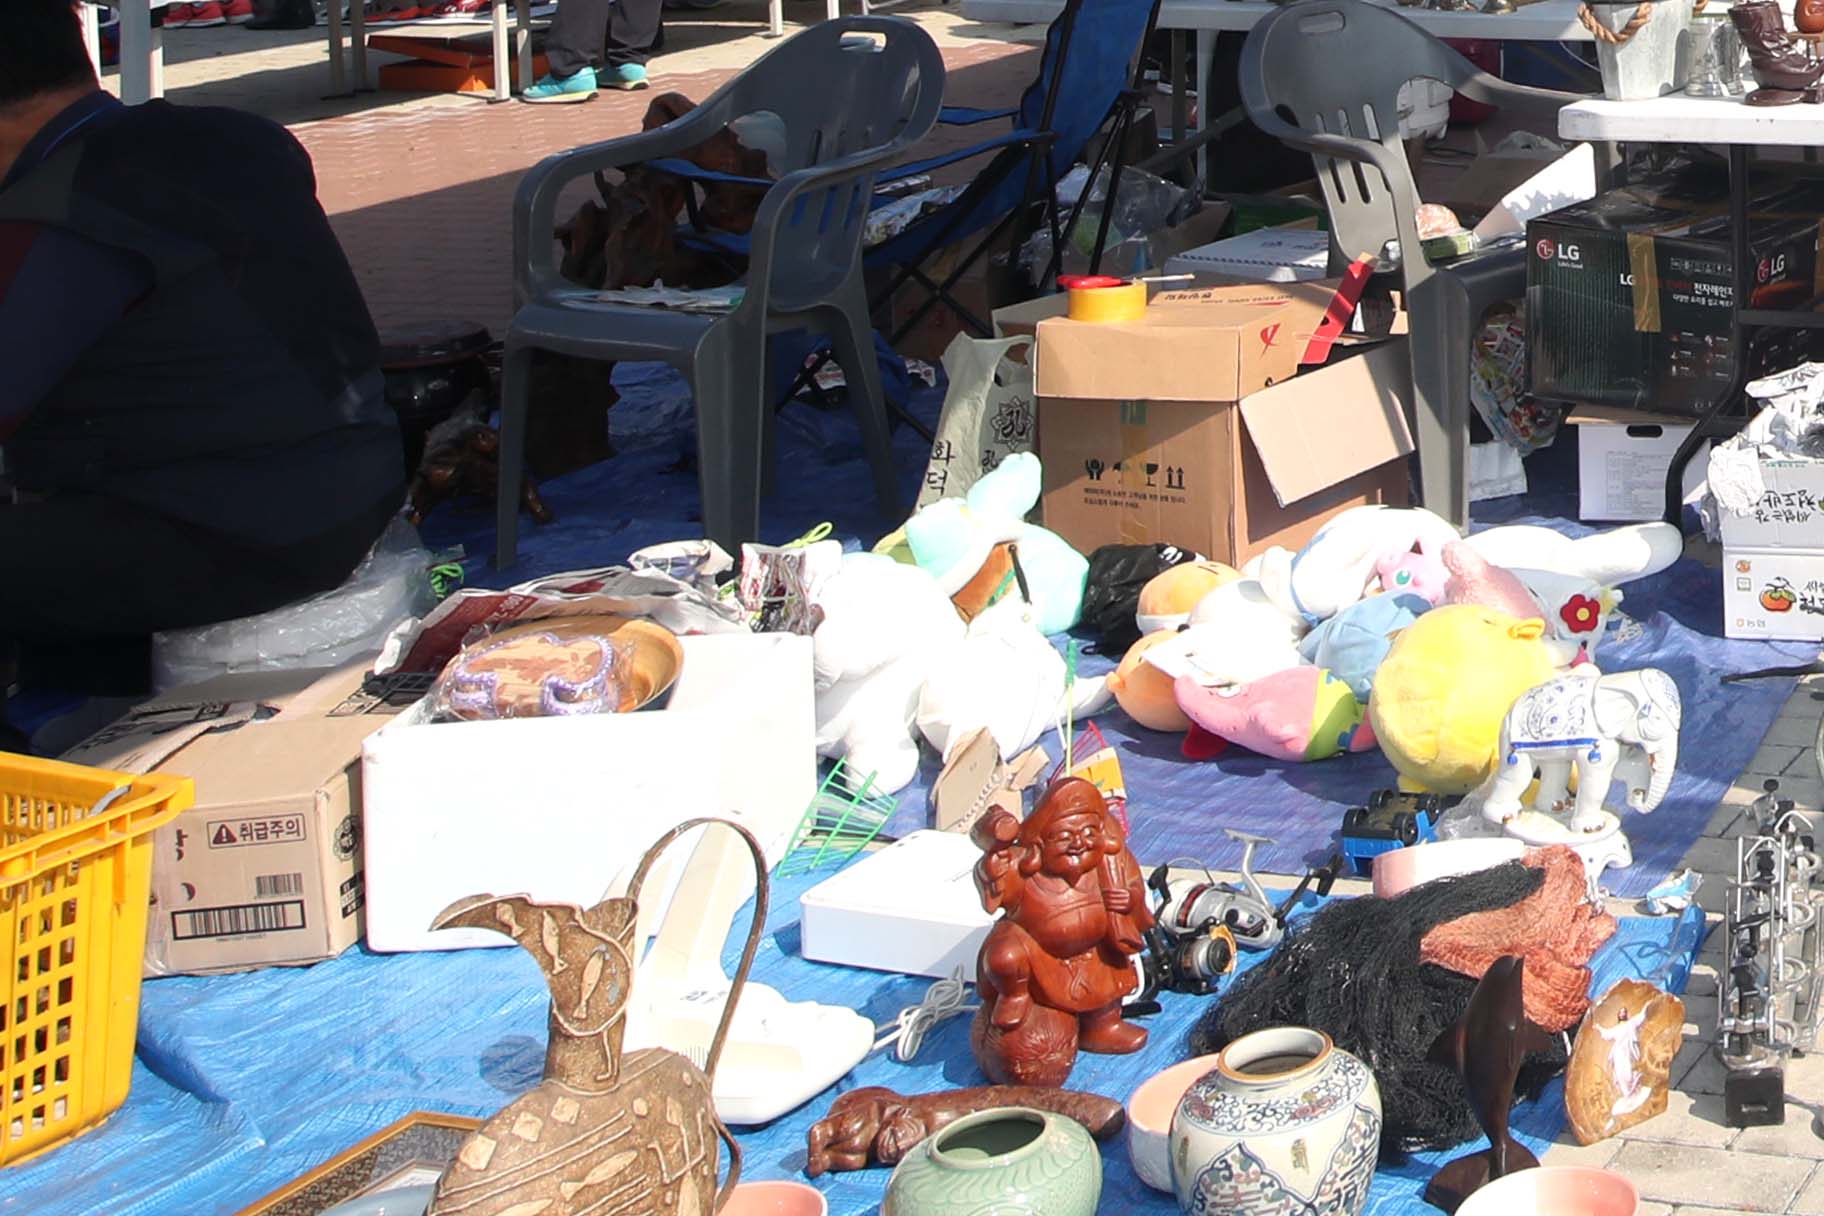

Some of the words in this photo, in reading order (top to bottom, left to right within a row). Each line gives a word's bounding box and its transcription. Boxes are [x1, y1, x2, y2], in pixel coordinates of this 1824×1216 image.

[1557, 243, 1580, 261] LG
[1770, 253, 1785, 276] LG
[1756, 488, 1816, 511] 청도반
[239, 817, 300, 842] 취급주의
